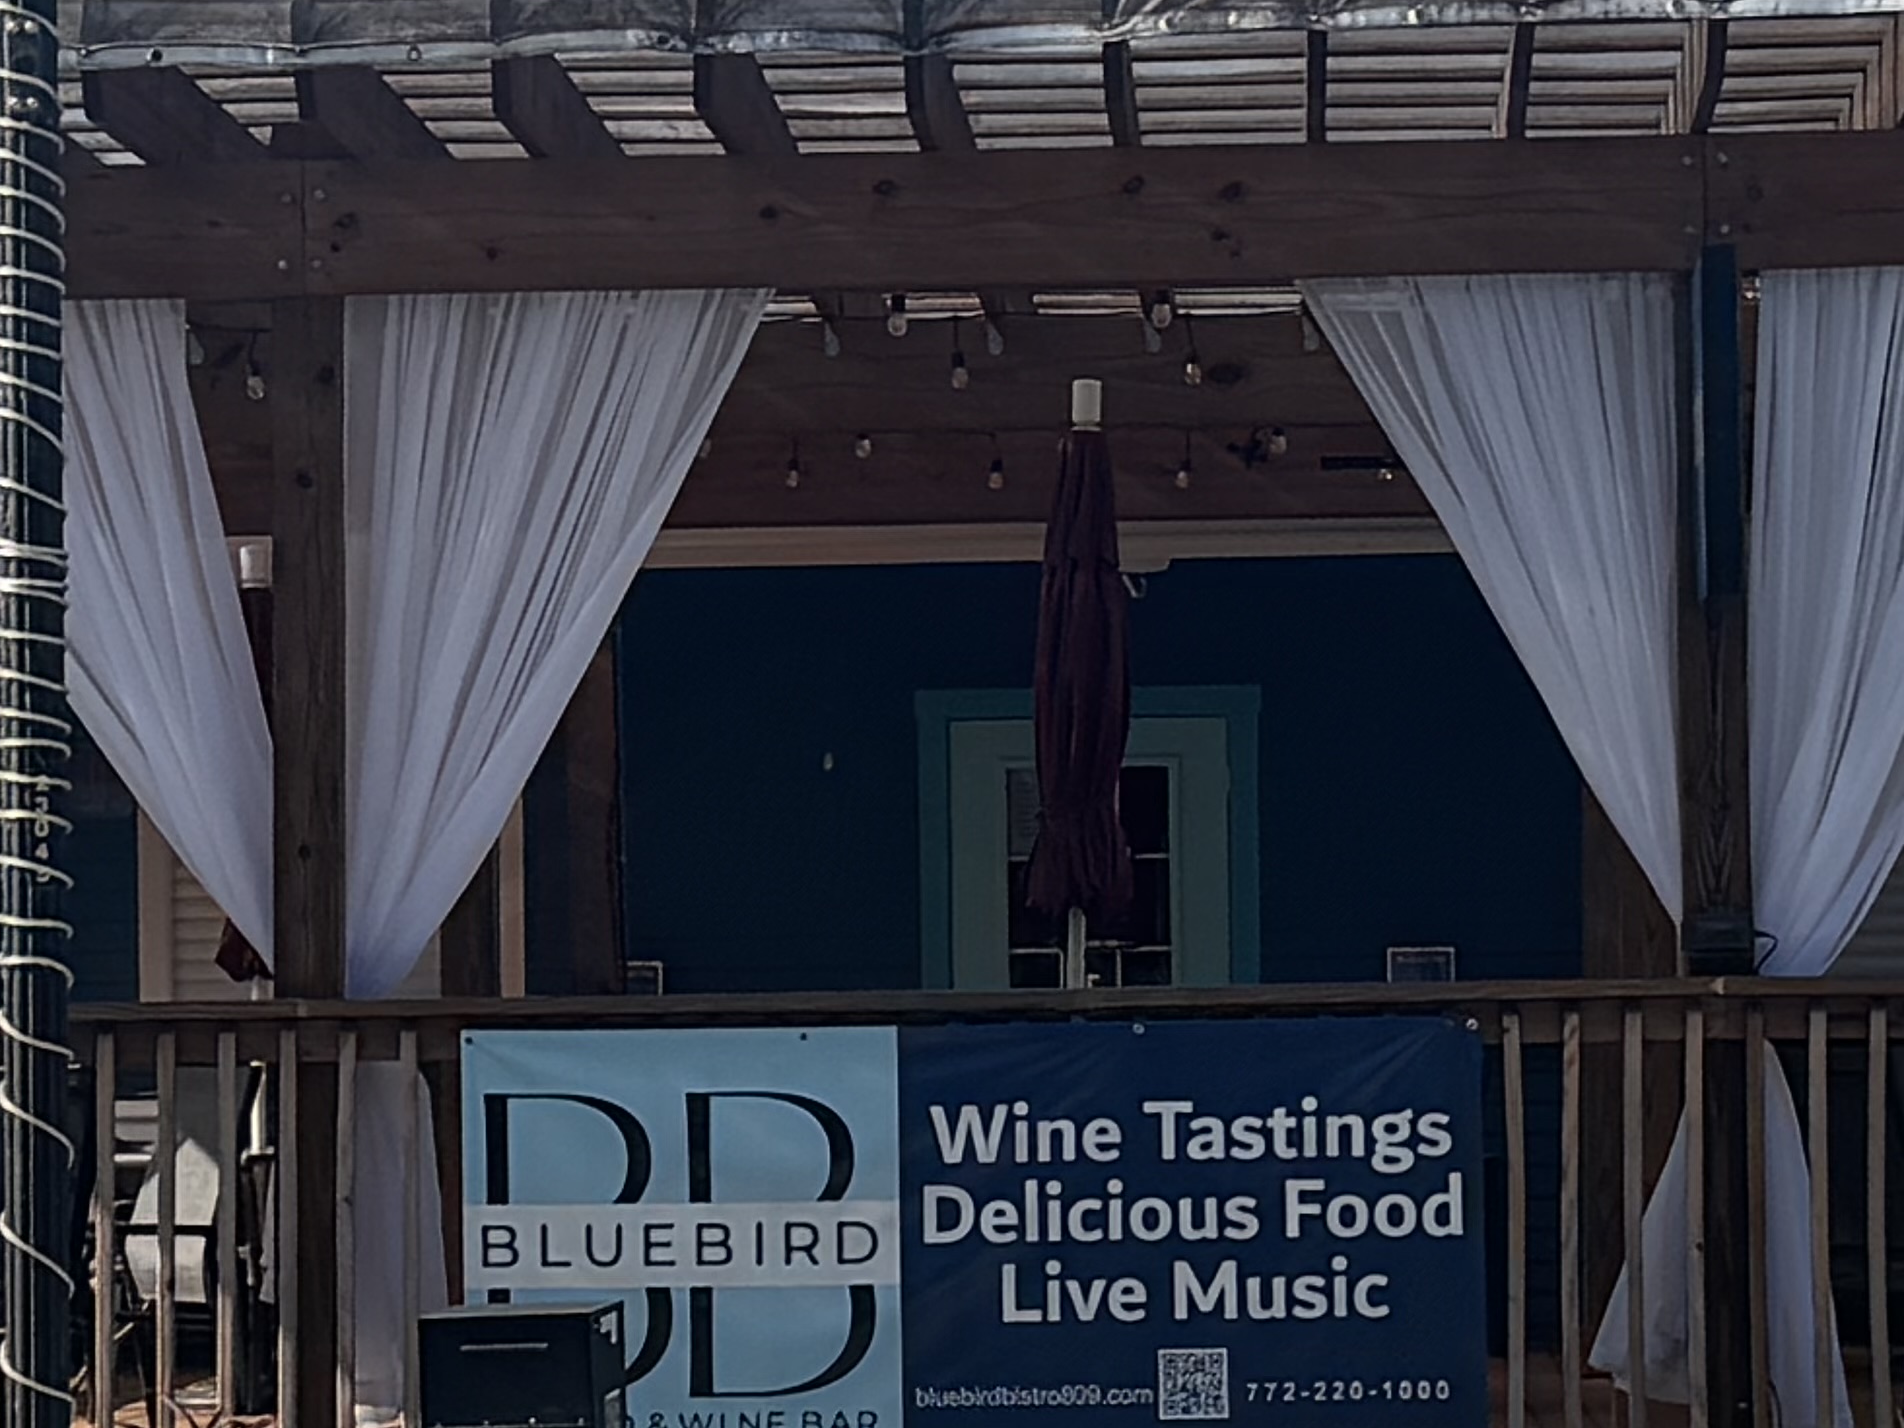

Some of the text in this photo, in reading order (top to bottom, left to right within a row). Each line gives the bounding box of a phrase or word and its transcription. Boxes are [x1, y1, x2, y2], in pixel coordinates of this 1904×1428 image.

[929, 1095, 1453, 1173] Wine Tastings
[922, 1172, 1464, 1244] Delicious Food
[481, 1221, 880, 1269] BLUEBIRD
[1001, 1255, 1391, 1323] Live Music
[914, 1383, 1154, 1408] bluebirdbistro809.com
[1246, 1379, 1451, 1403] 772-220-1000
